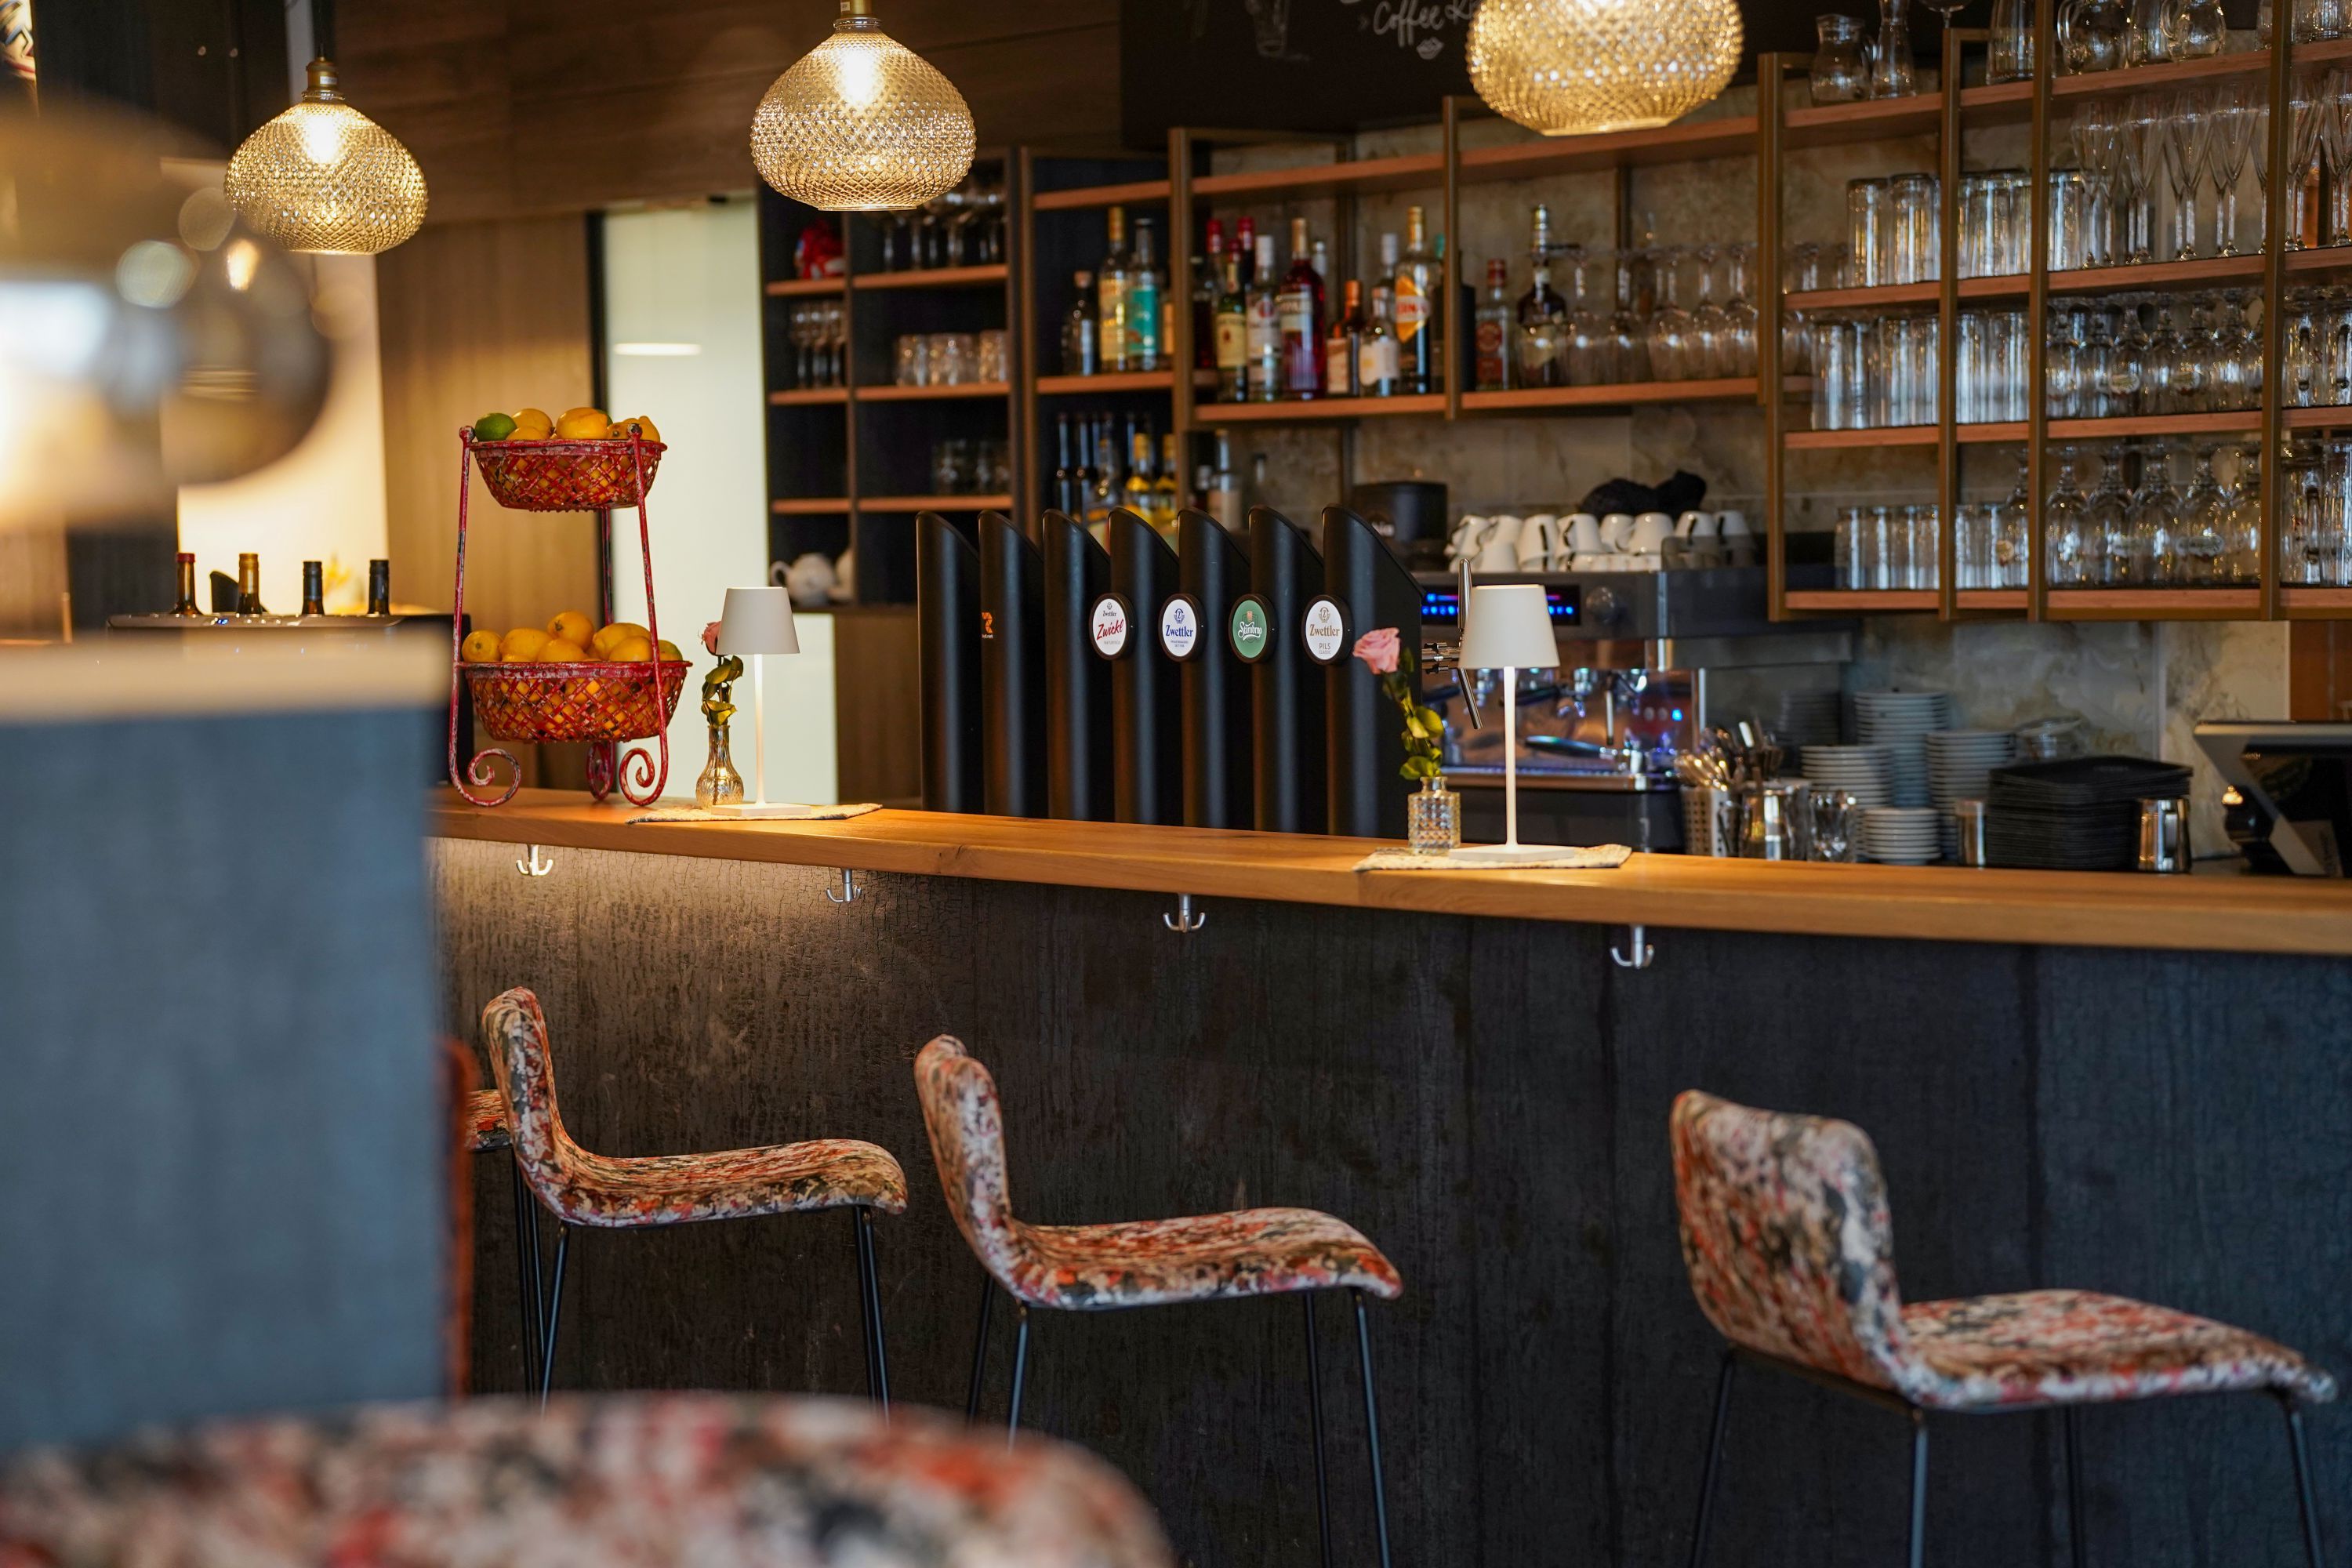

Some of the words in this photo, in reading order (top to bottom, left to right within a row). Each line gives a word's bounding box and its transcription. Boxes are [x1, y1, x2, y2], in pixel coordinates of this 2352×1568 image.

[1374, 0, 1443, 47] Coffee
[1097, 619, 1123, 640] Zwickl
[1166, 625, 1193, 637] Zwettler
[1310, 623, 1340, 637] Zwettler
